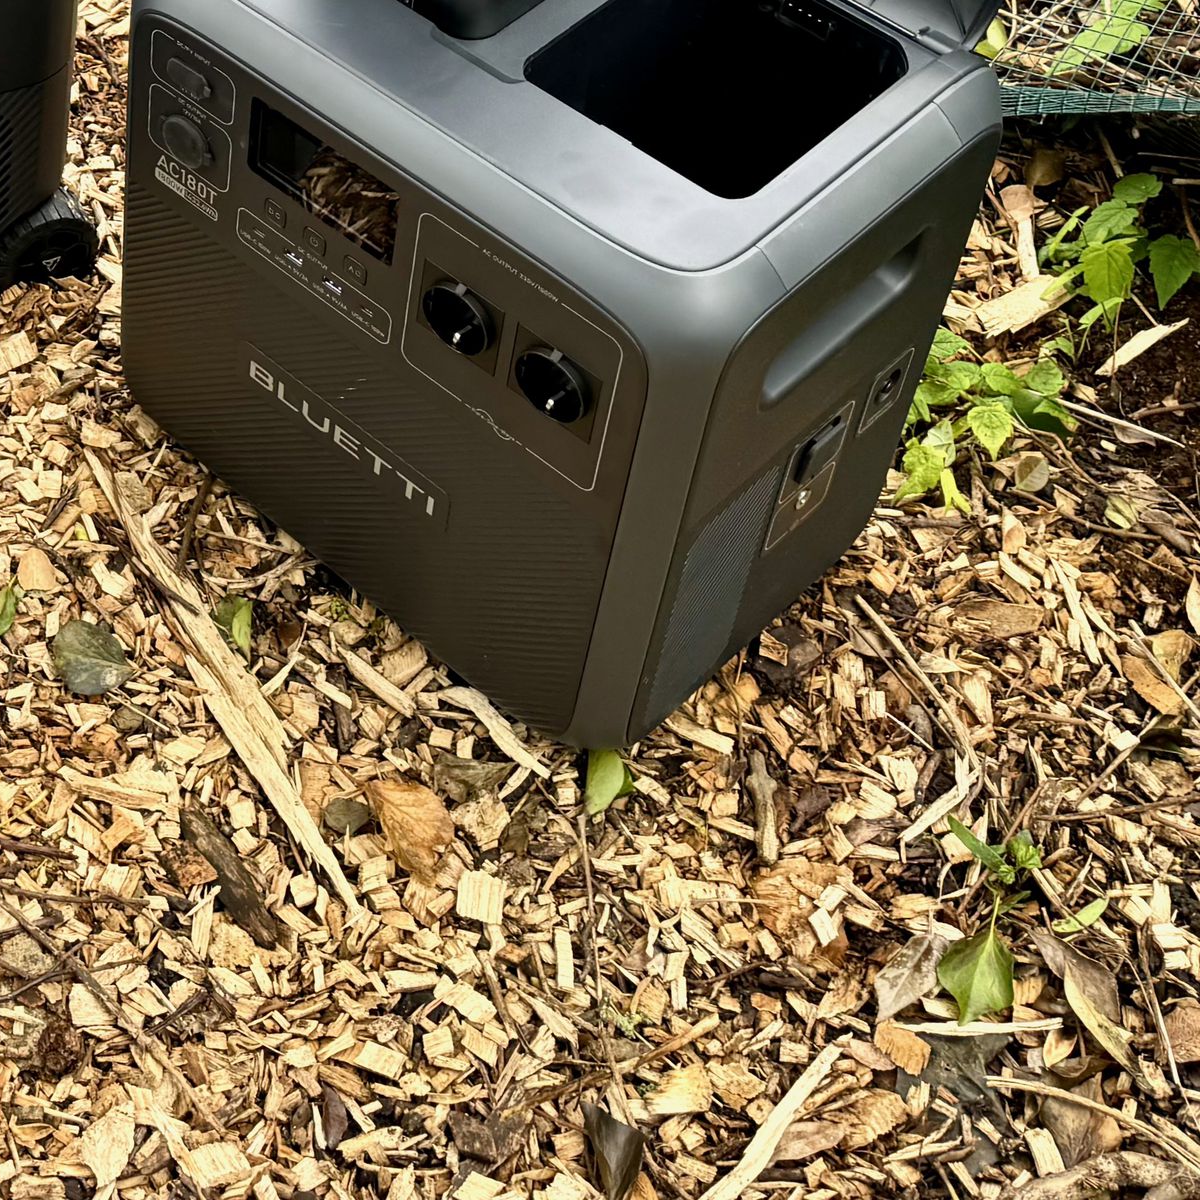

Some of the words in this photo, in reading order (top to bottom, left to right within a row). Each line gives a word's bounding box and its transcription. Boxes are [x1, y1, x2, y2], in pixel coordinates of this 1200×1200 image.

[156, 154, 218, 205] AC180T
[157, 169, 185, 194] 1800W
[306, 253, 328, 271] OUTPUT
[348, 266, 362, 278] AC
[482, 249, 492, 258] AC
[492, 255, 519, 276] OUTPUT
[250, 360, 435, 516] BLUETTI
